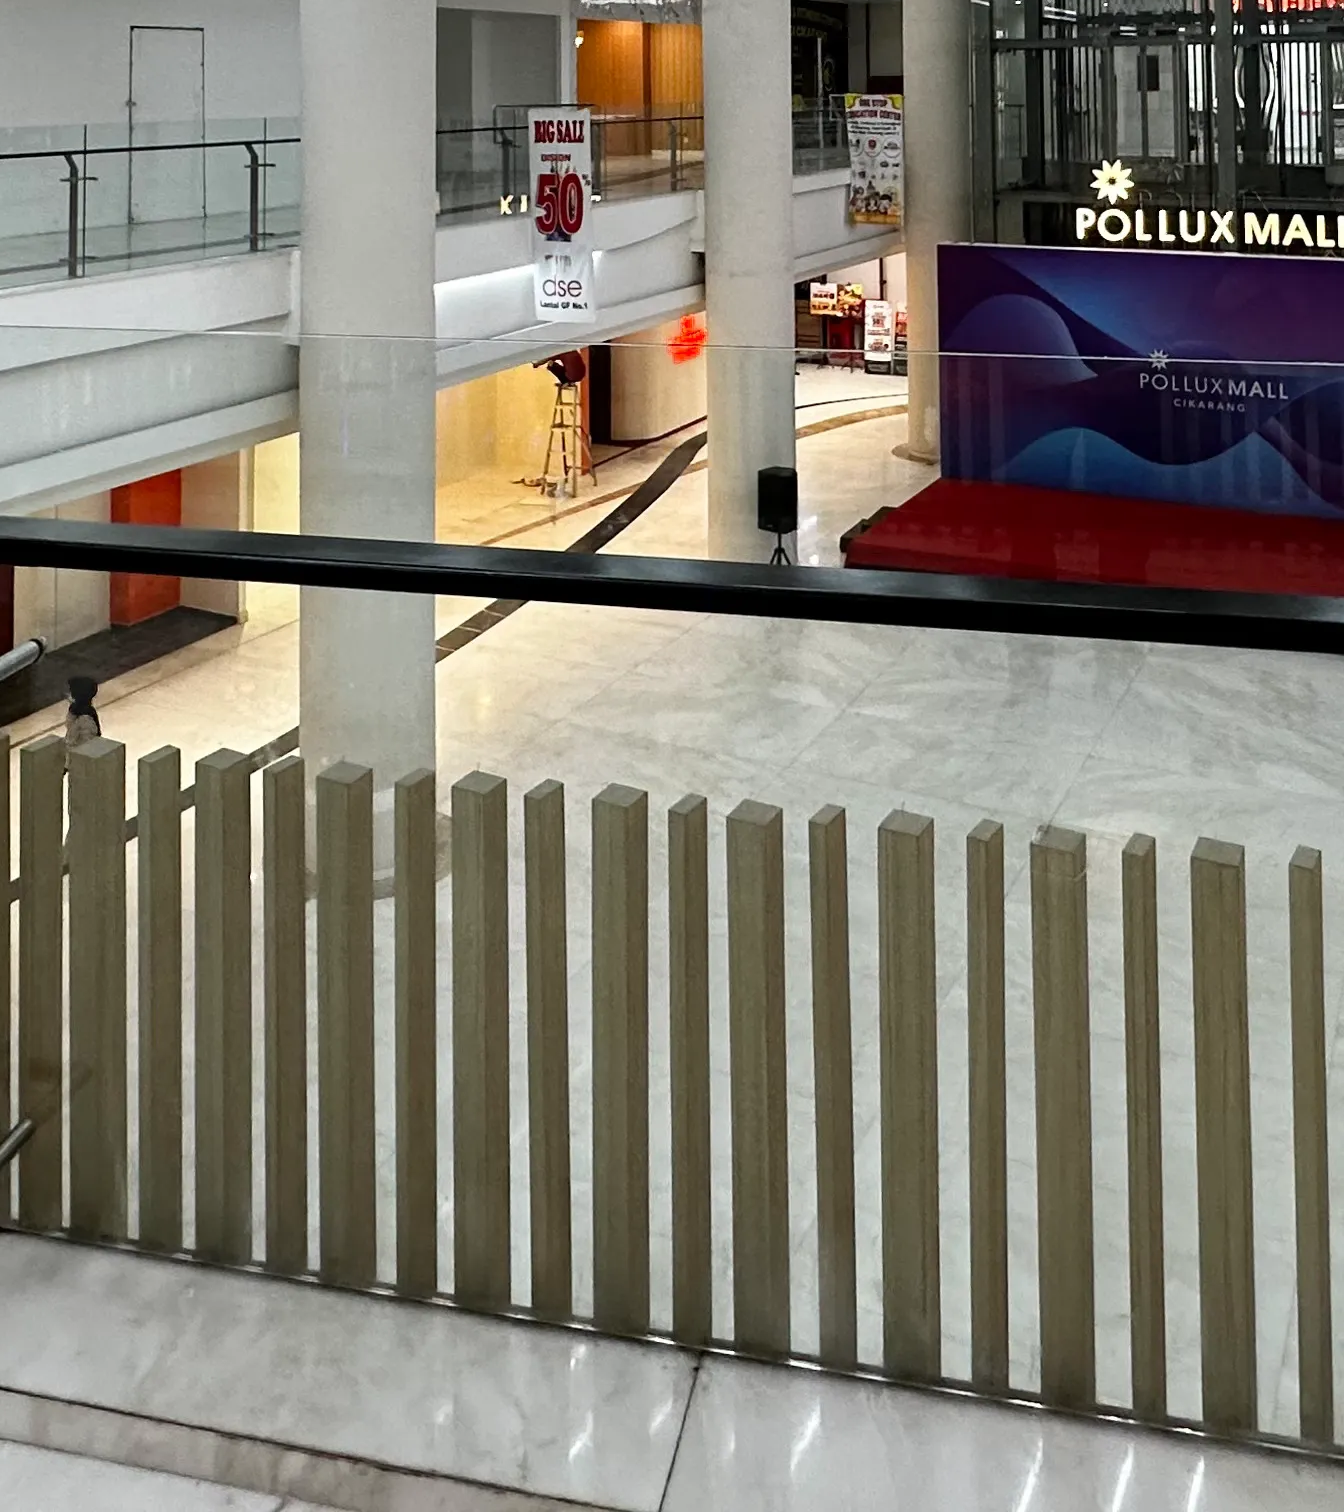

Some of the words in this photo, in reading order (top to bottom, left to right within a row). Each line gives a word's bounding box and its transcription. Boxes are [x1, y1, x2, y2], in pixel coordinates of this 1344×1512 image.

[533, 119, 555, 144] BIG
[1075, 207, 1235, 244] POLLUX
[1139, 372, 1224, 395] POLLUX
[1228, 378, 1289, 400] MALL
[1173, 398, 1247, 413] CIKARANG
